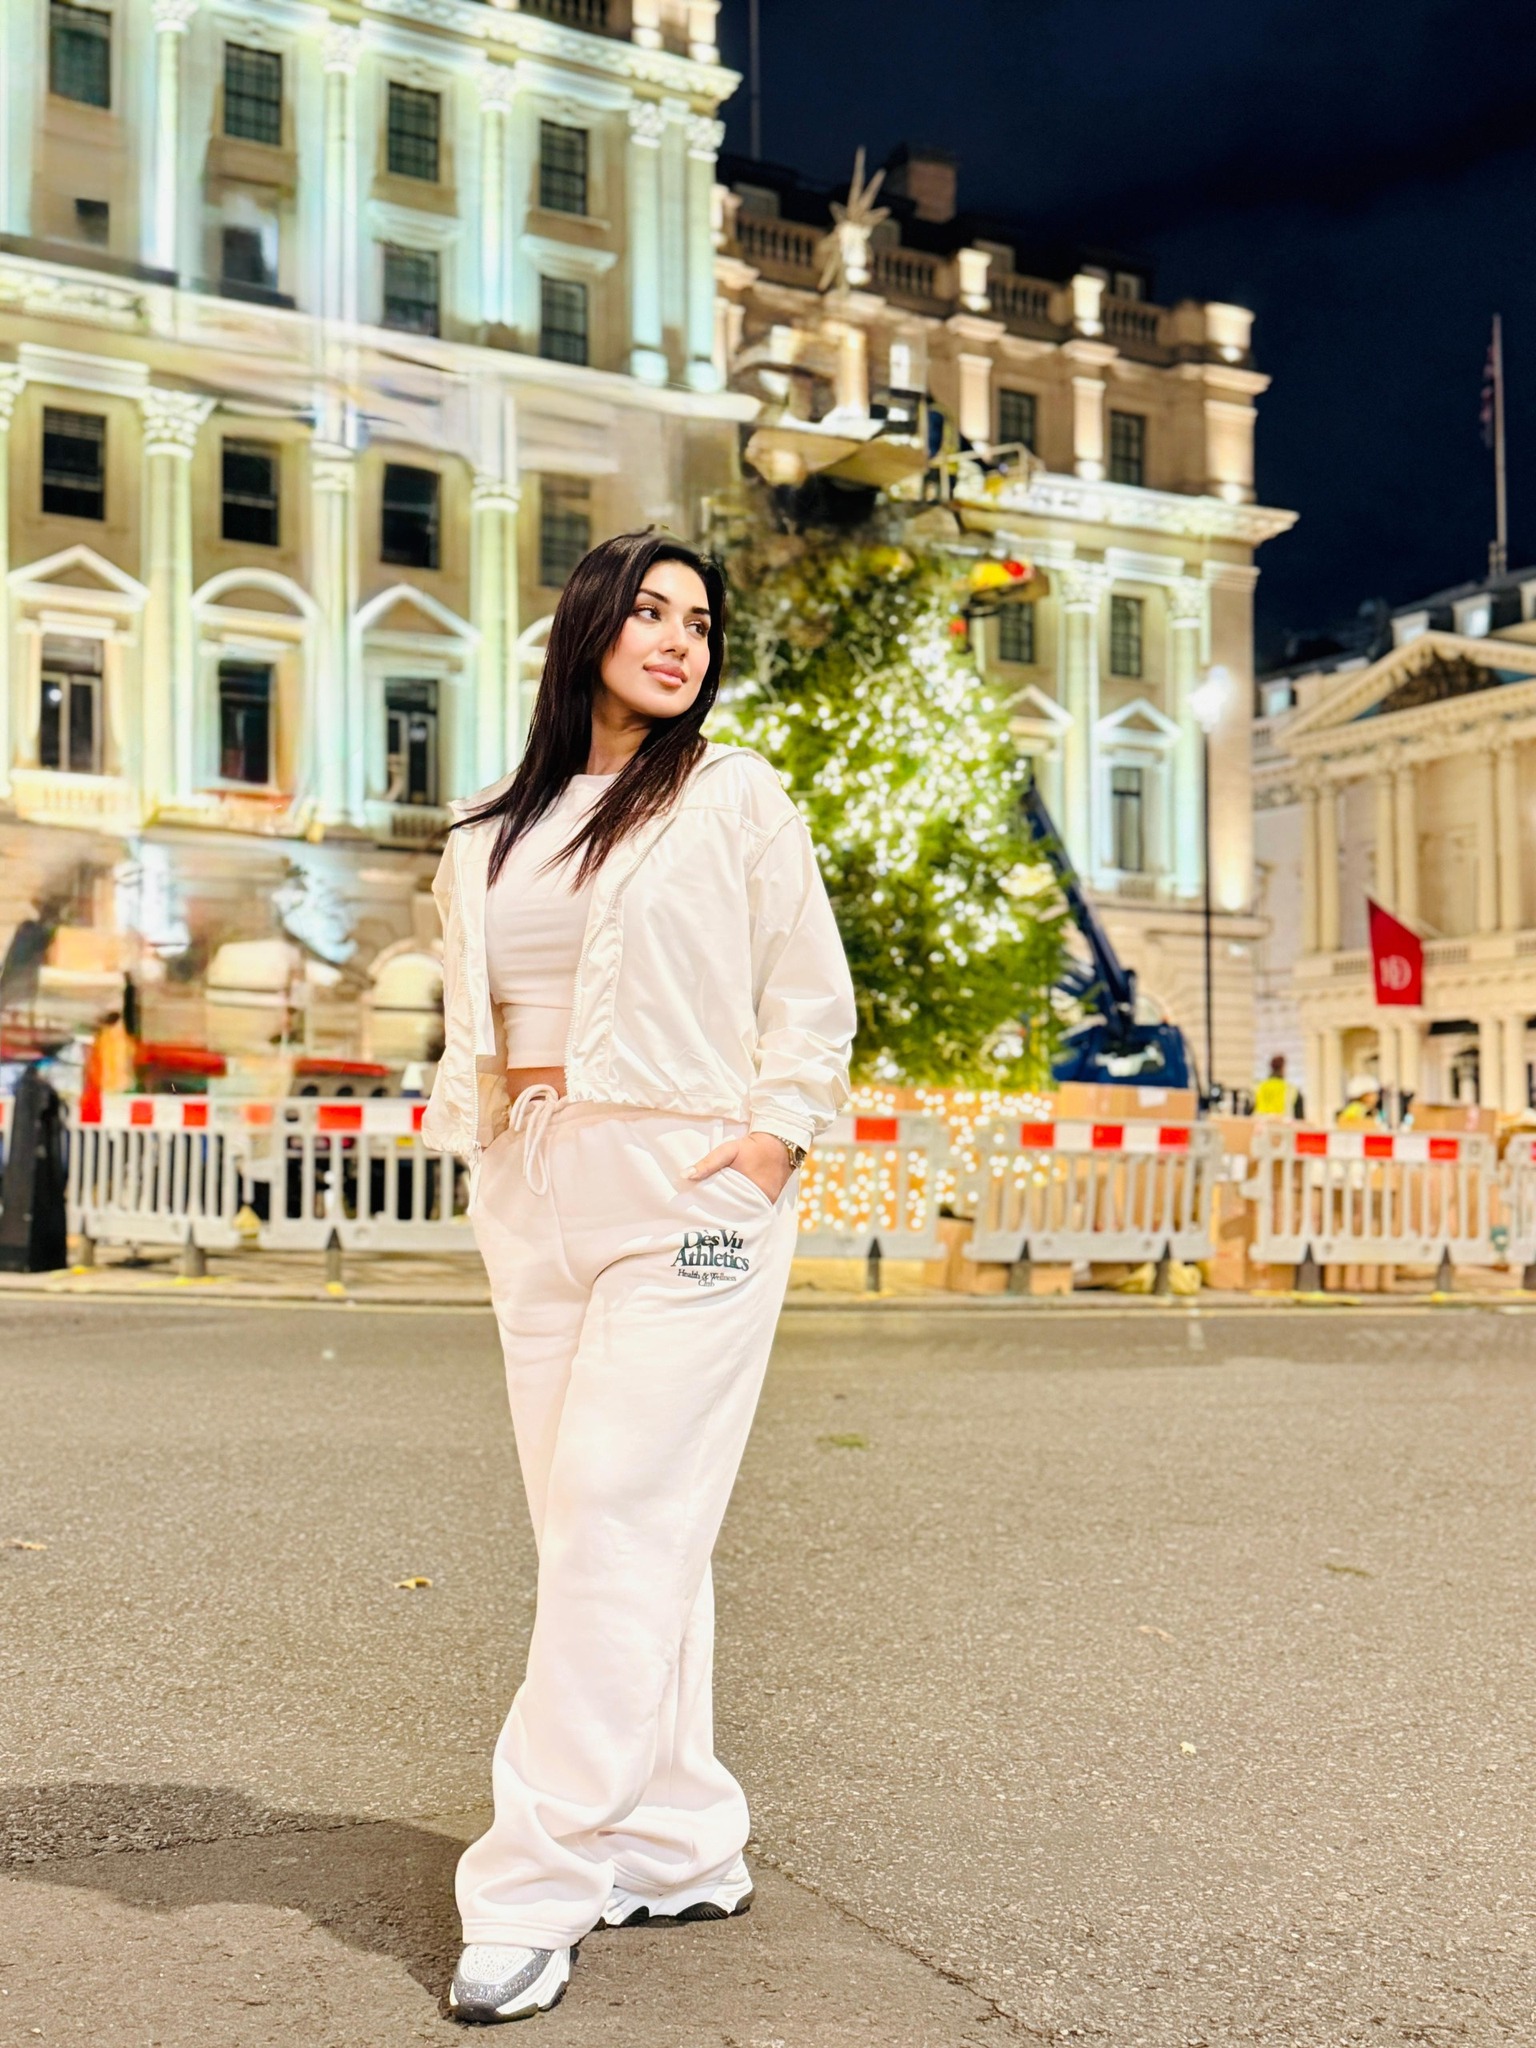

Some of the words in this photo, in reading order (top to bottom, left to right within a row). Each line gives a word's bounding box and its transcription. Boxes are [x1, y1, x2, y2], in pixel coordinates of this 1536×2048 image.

[718, 1229, 744, 1249] Vu
[670, 1244, 750, 1272] Athletics
[677, 1268, 701, 1280] Health
[702, 1272, 709, 1281] &
